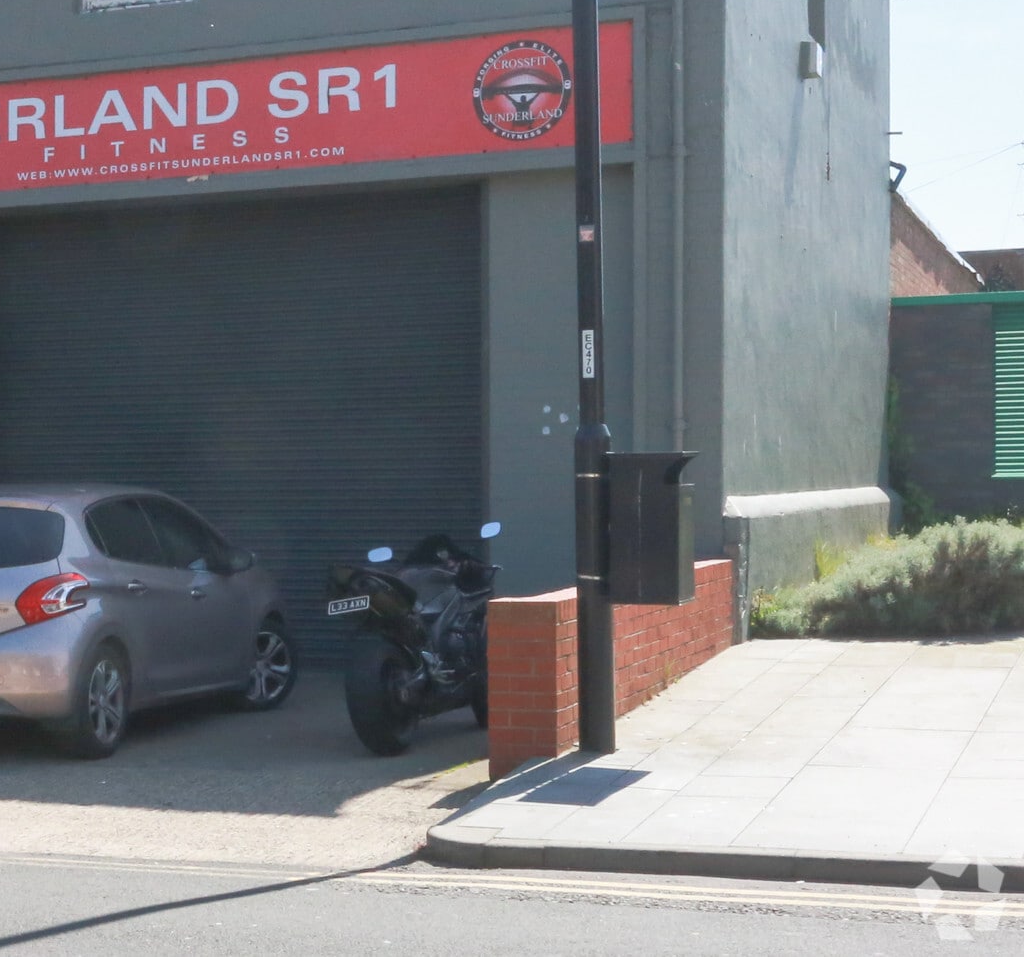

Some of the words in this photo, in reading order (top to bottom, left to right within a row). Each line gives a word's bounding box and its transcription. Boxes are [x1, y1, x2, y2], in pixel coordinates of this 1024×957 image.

[493, 56, 548, 70] CROSSFIT
[533, 43, 563, 65] ELITE
[267, 64, 397, 119] SR1
[482, 108, 563, 124] SUNDERLAND
[43, 127, 290, 163] FITNESS
[585, 334, 593, 374] EC470
